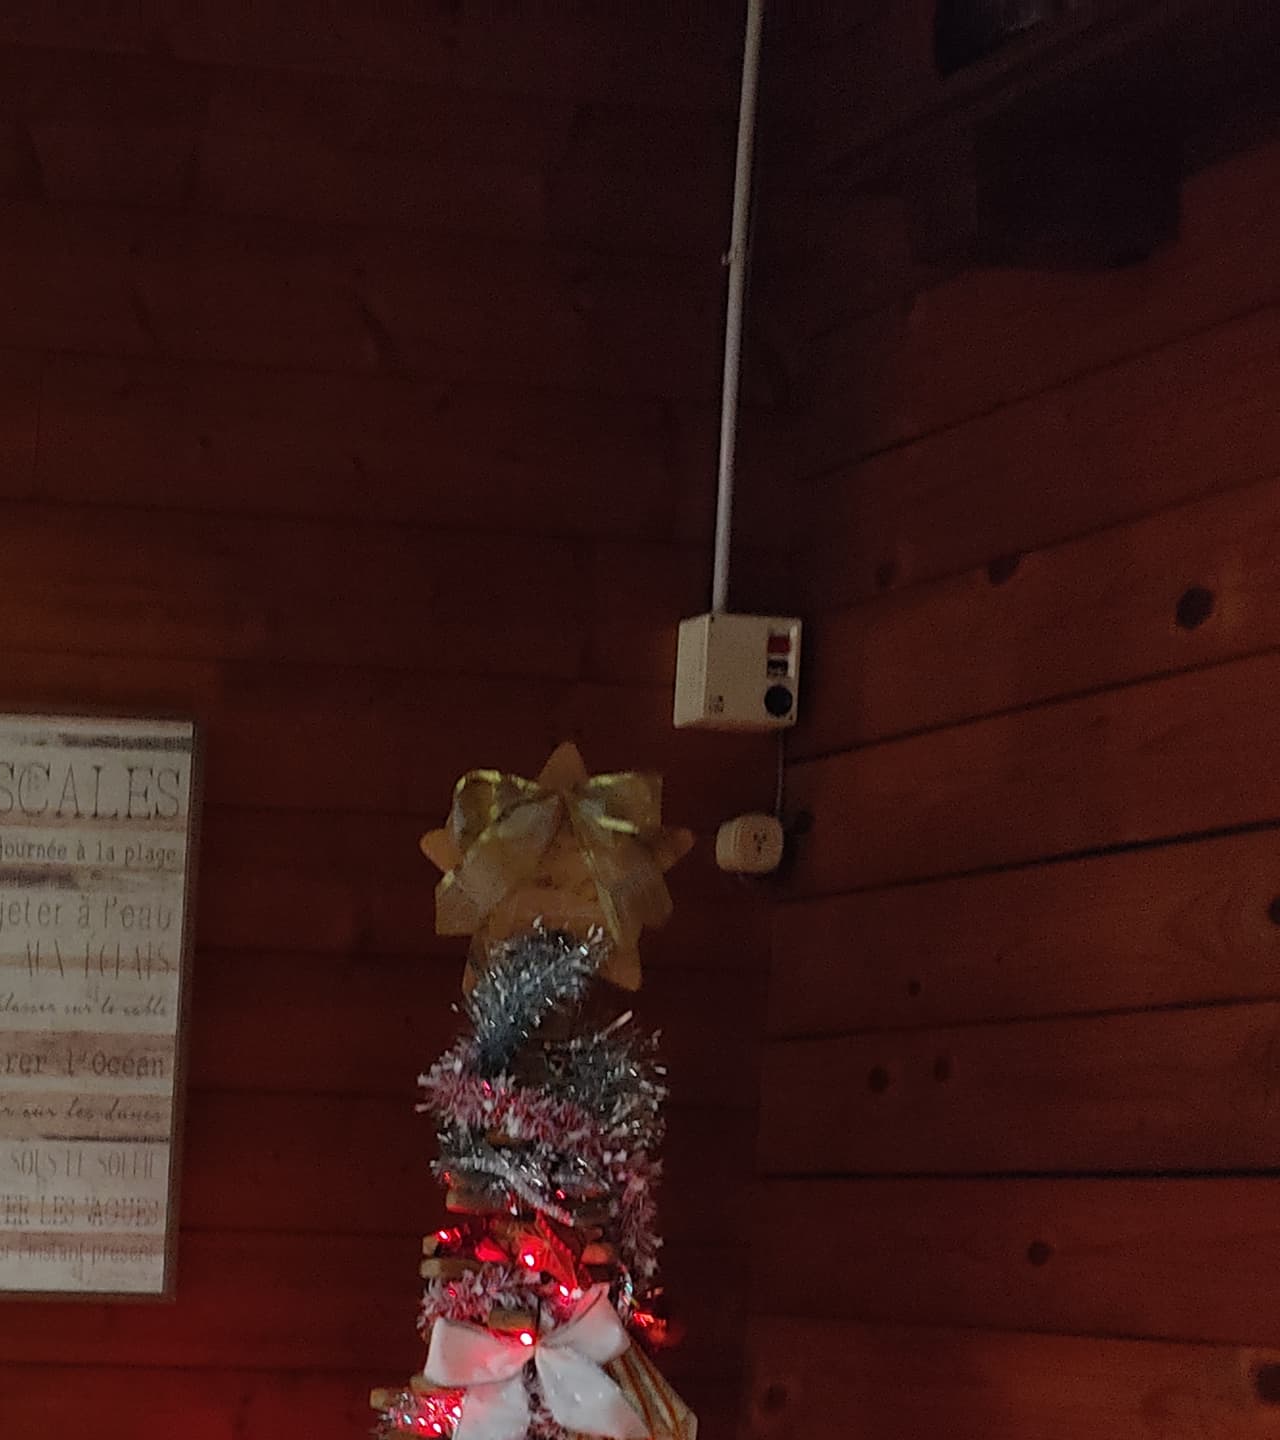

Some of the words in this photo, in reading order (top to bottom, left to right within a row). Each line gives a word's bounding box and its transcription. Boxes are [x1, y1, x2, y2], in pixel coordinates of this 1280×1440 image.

[96, 839, 115, 861] la
[124, 840, 177, 868] plage
[103, 894, 172, 930] l'eau
[10, 1146, 57, 1179] SOUS
